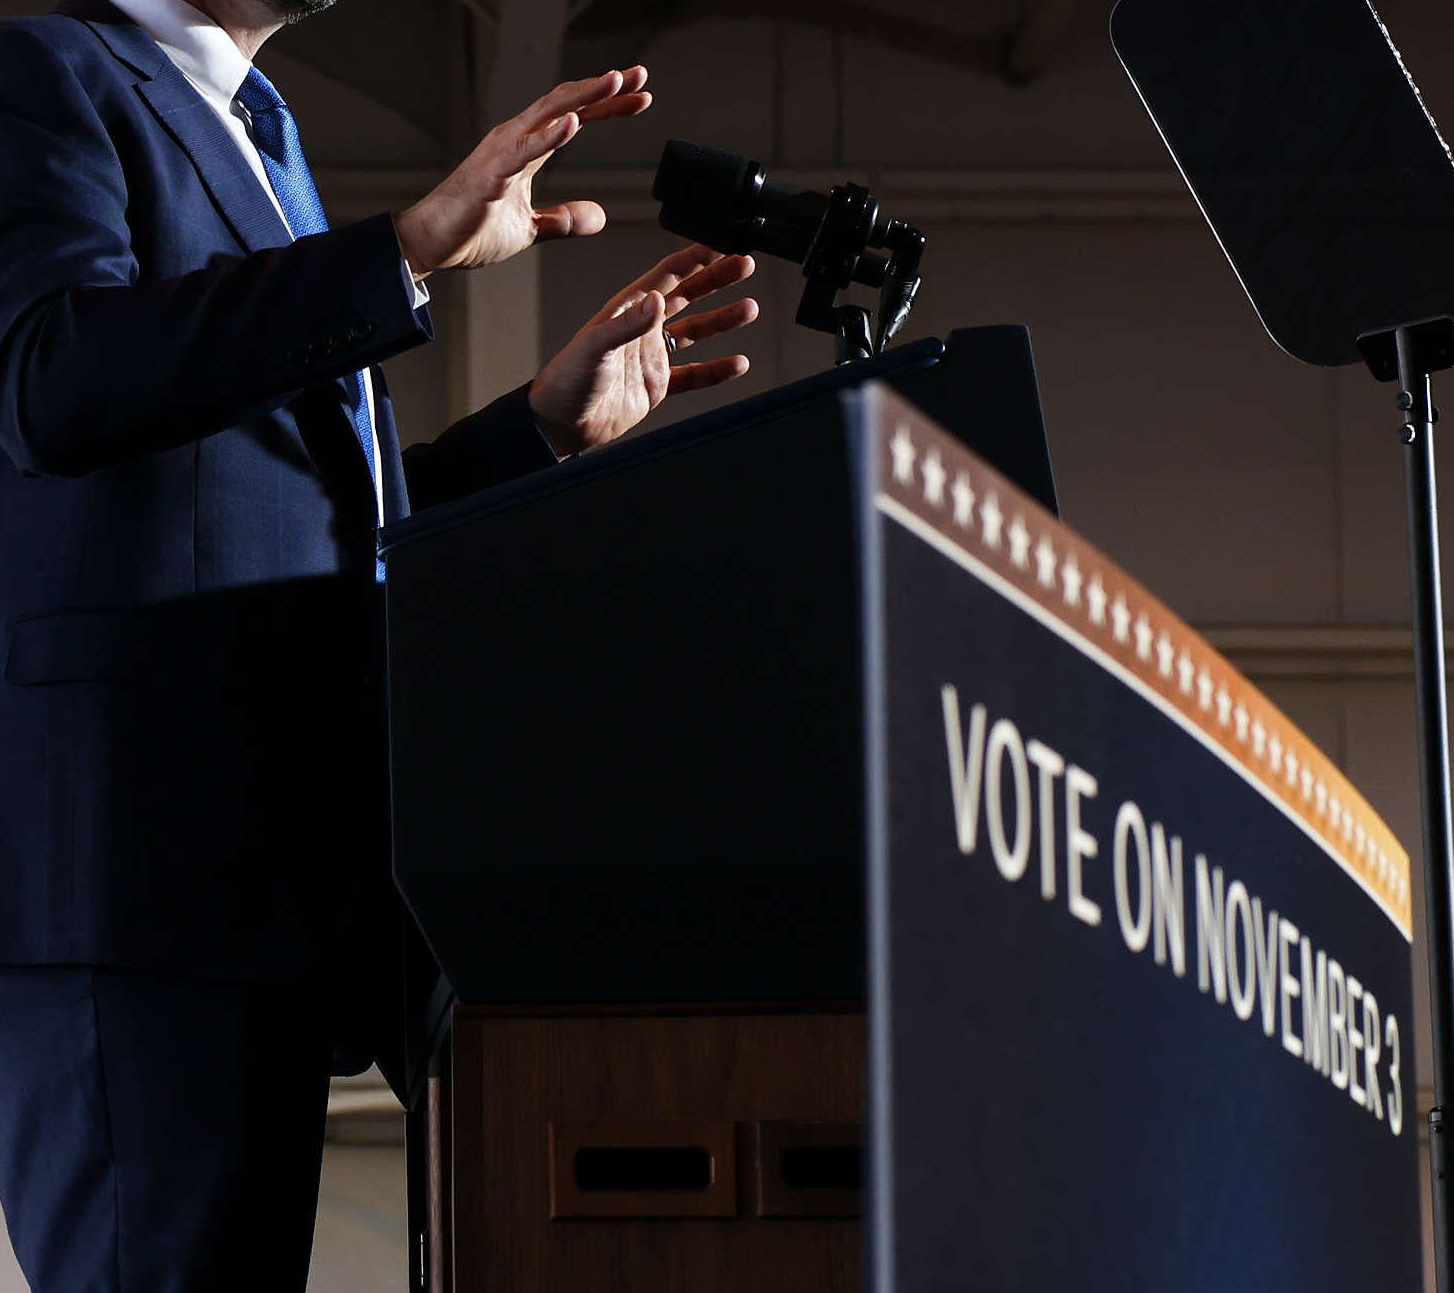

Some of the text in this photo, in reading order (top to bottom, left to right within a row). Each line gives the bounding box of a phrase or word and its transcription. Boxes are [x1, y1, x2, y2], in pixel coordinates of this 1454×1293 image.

[940, 684, 1403, 1137] VOTE ON NOVEMBER 3
